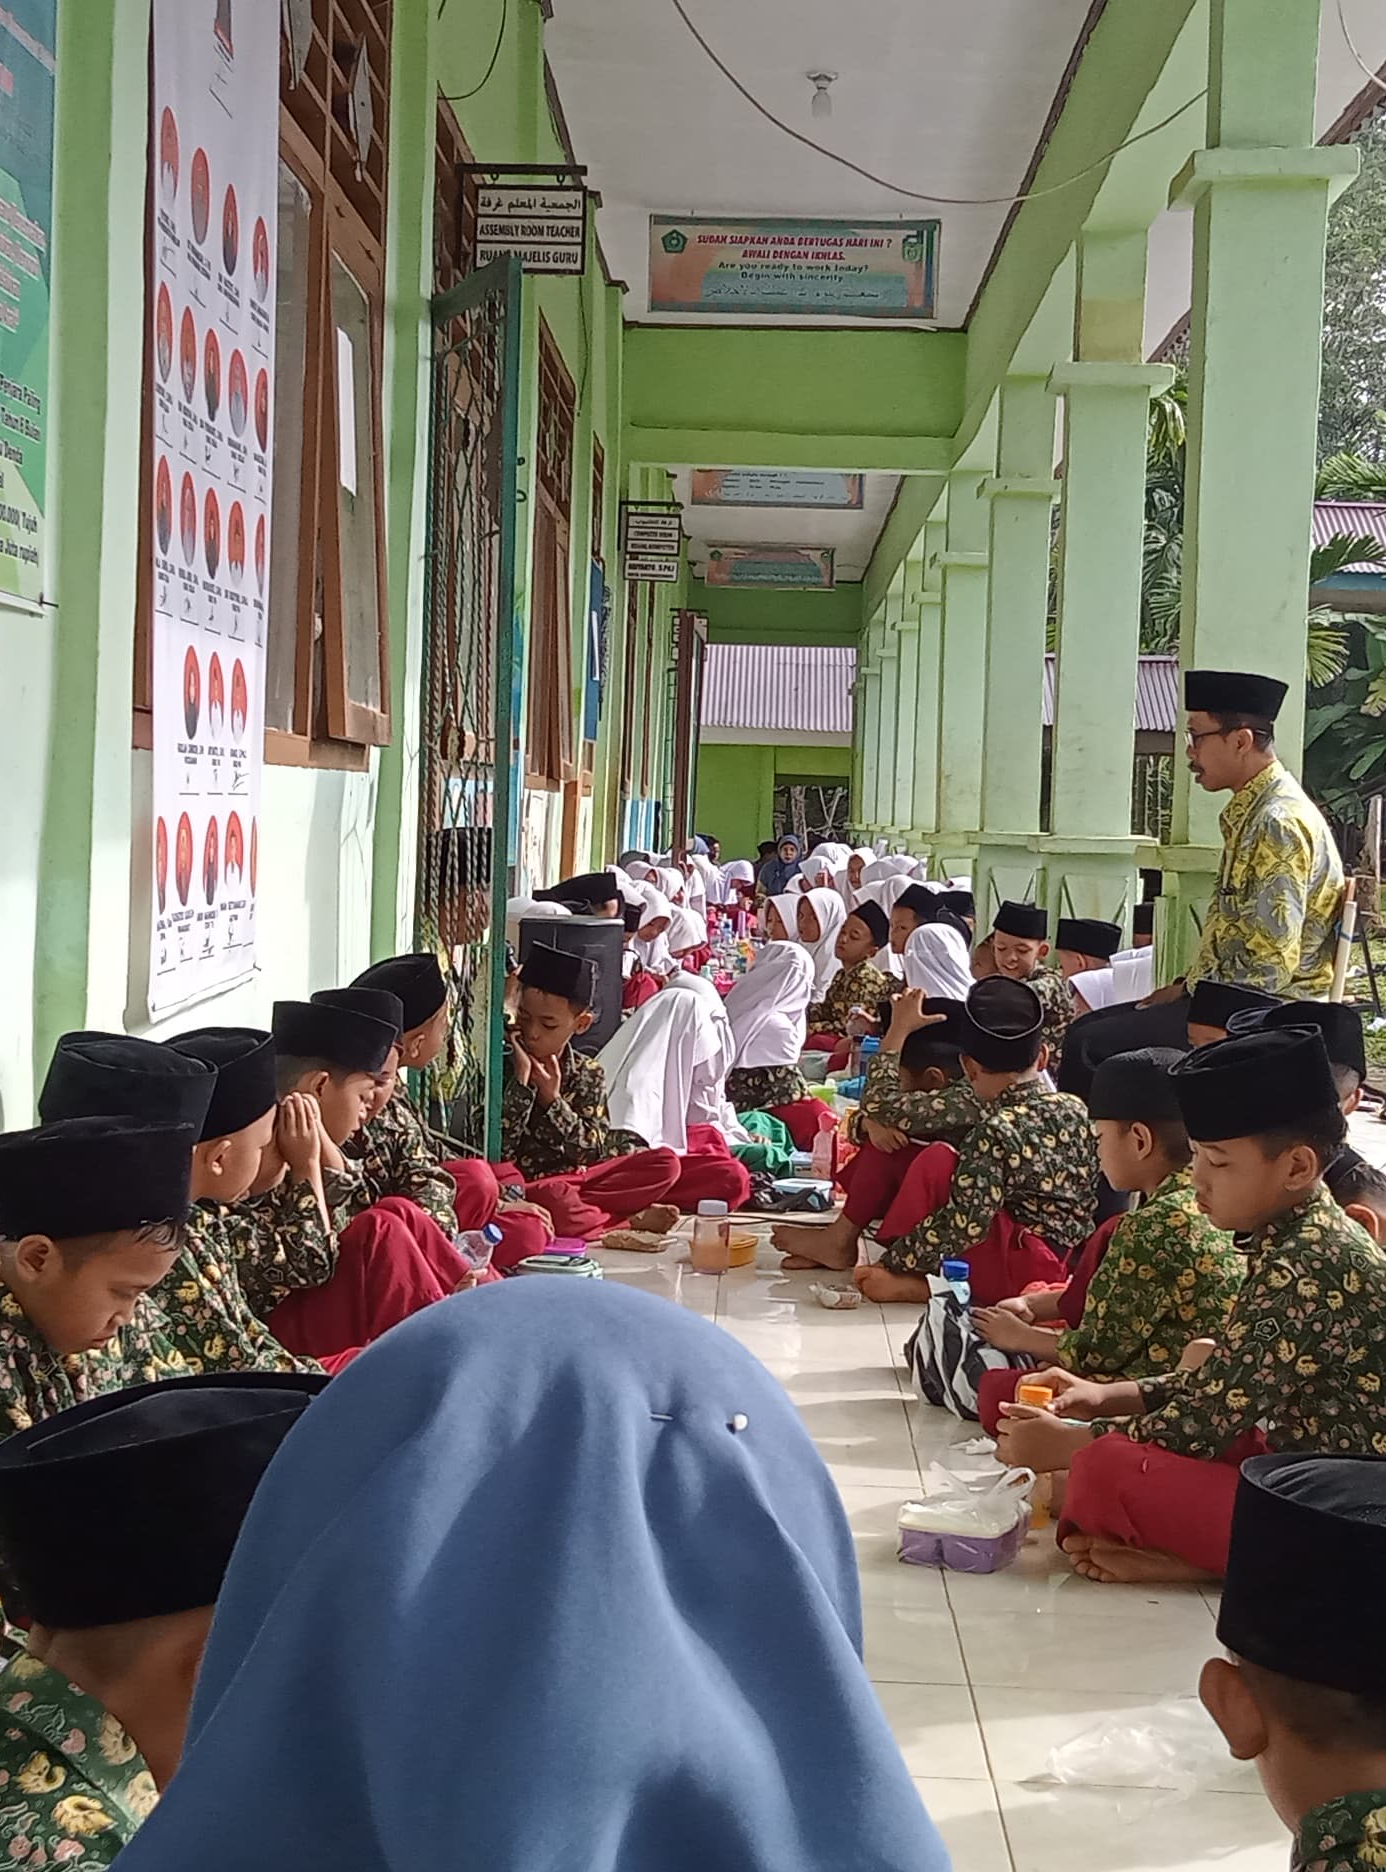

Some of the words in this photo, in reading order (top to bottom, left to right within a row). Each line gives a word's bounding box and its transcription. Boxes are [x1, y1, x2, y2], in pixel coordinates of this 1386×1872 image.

[479, 223, 519, 237] ASSEMBLY
[521, 225, 544, 237] ROOM
[546, 225, 580, 238] TEACHER
[770, 236, 795, 246] ANDA
[553, 251, 578, 264] GURU
[742, 249, 770, 259] AWALI
[772, 250, 808, 260] DENGAN
[718, 261, 735, 269] Are
[739, 263, 757, 271] you
[760, 262, 789, 272] ready
[792, 263, 803, 271] to
[806, 263, 831, 272] work
[741, 271, 770, 281] Begin
[773, 272, 796, 281] with
